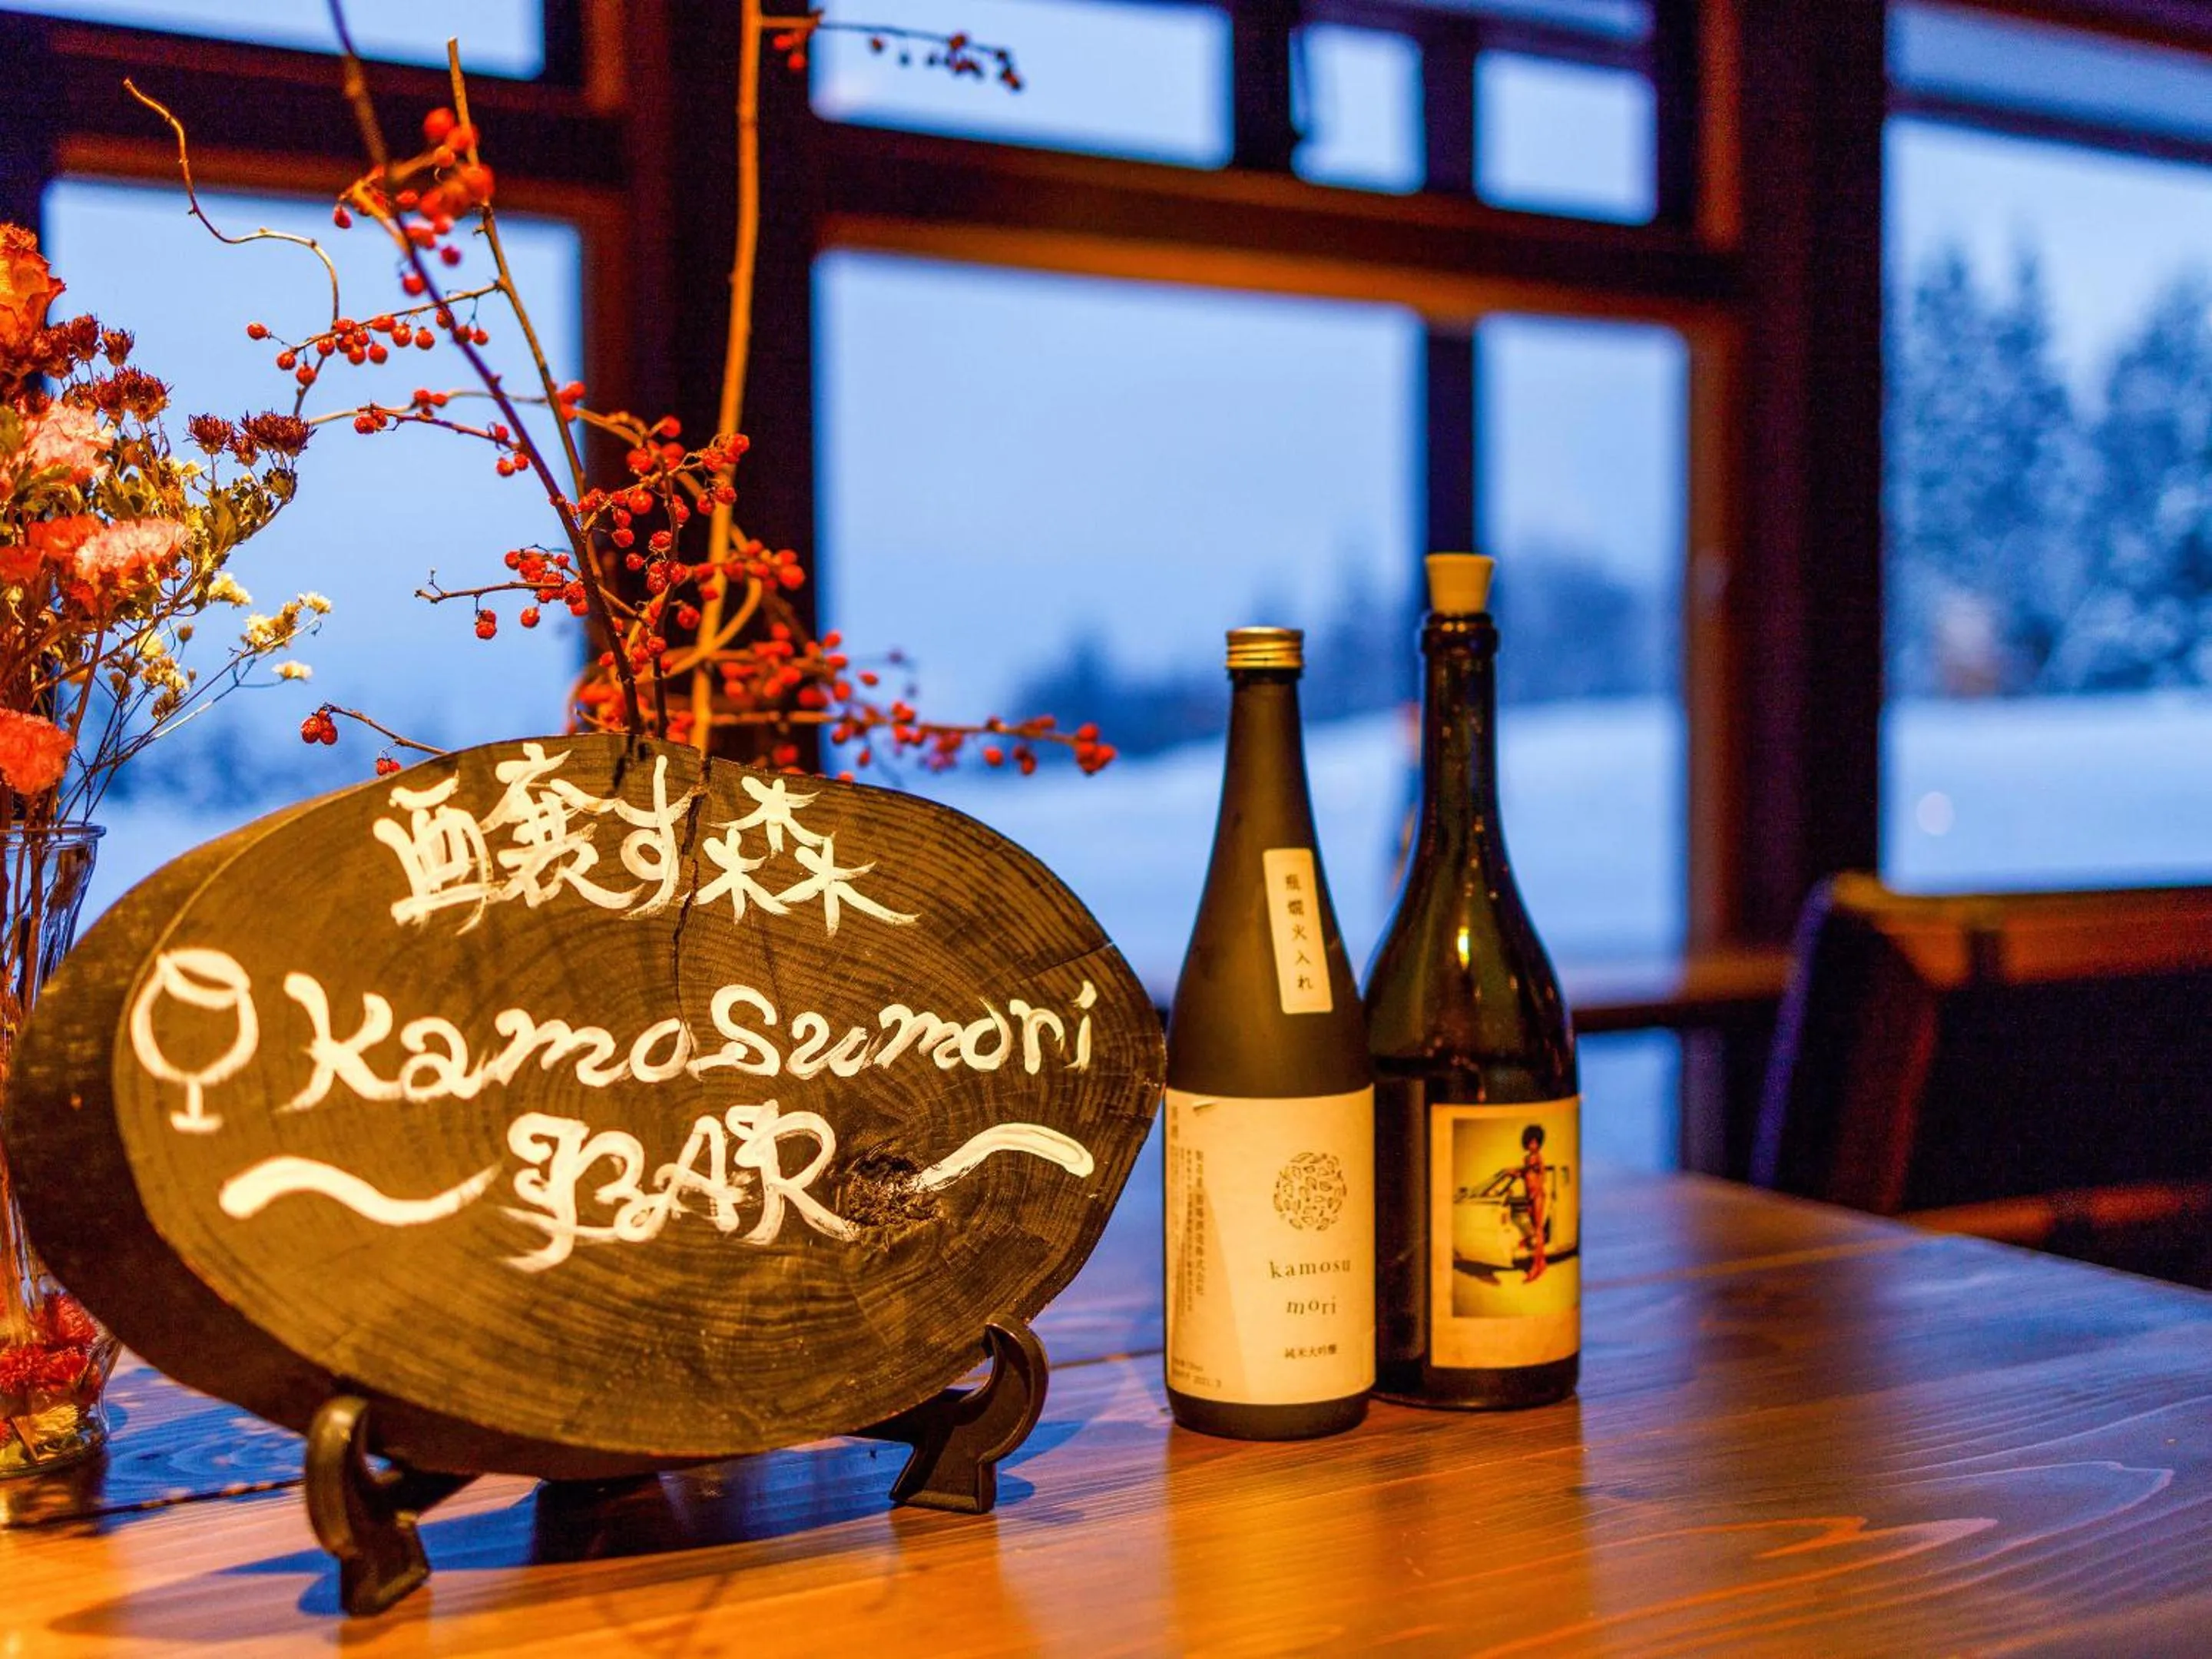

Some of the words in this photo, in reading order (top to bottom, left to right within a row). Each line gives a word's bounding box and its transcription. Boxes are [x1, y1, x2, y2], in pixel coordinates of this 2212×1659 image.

[501, 1100, 859, 1272] BAR
[1269, 1260, 1351, 1279] kamosu
[1286, 1296, 1337, 1315] mori
